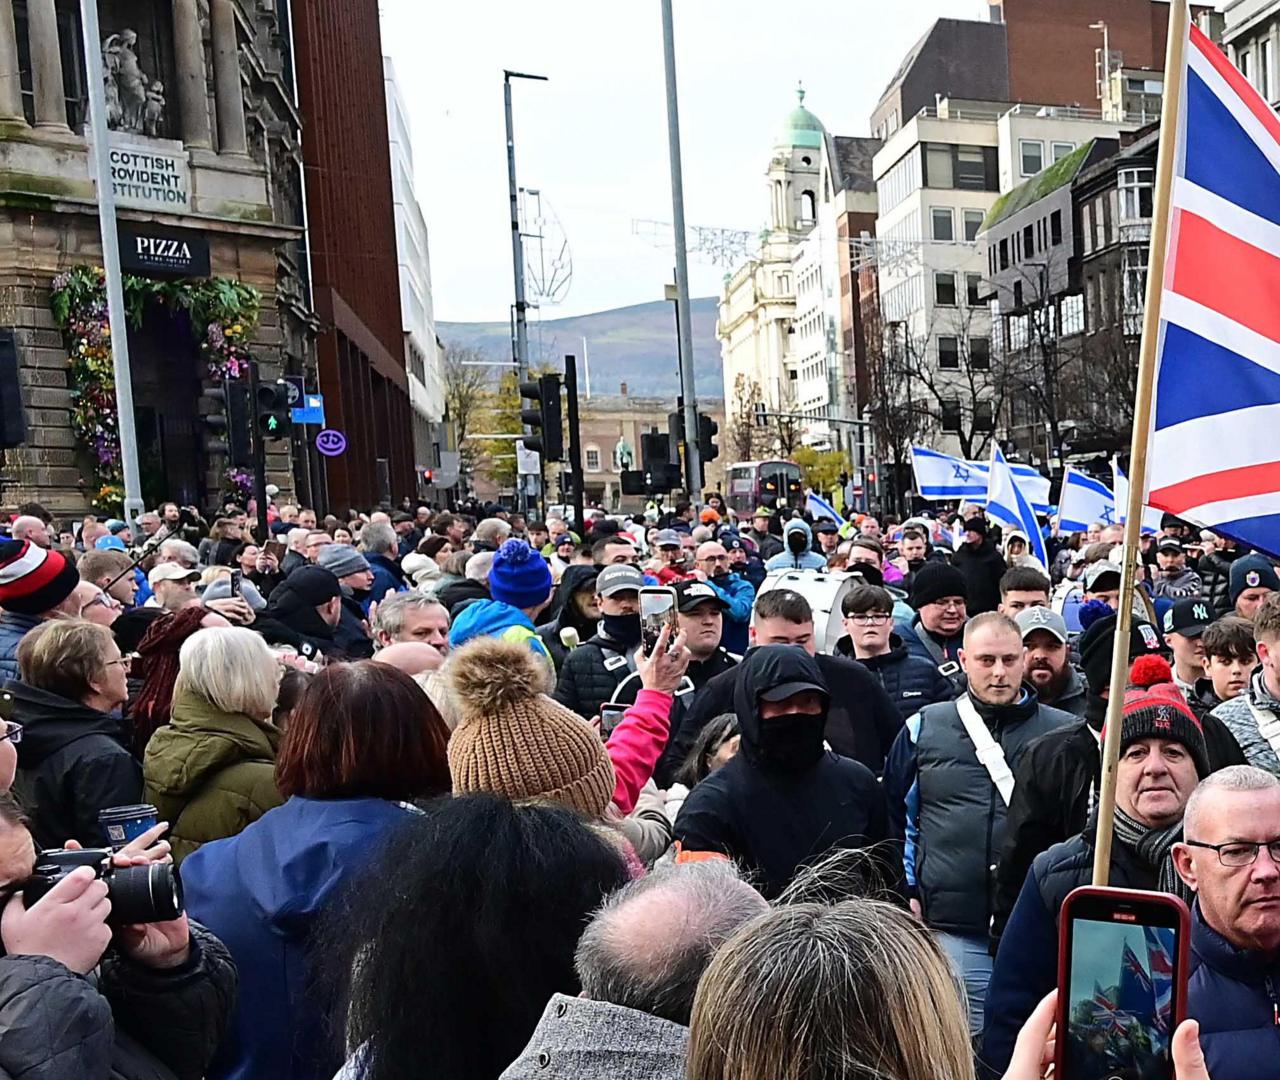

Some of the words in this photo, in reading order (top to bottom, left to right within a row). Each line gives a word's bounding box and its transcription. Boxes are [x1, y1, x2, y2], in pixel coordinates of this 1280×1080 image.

[110, 151, 175, 172] COTTISH
[111, 166, 180, 188] ROVIDENT
[112, 182, 187, 205] STITUTION
[136, 236, 192, 259] PIZZA
